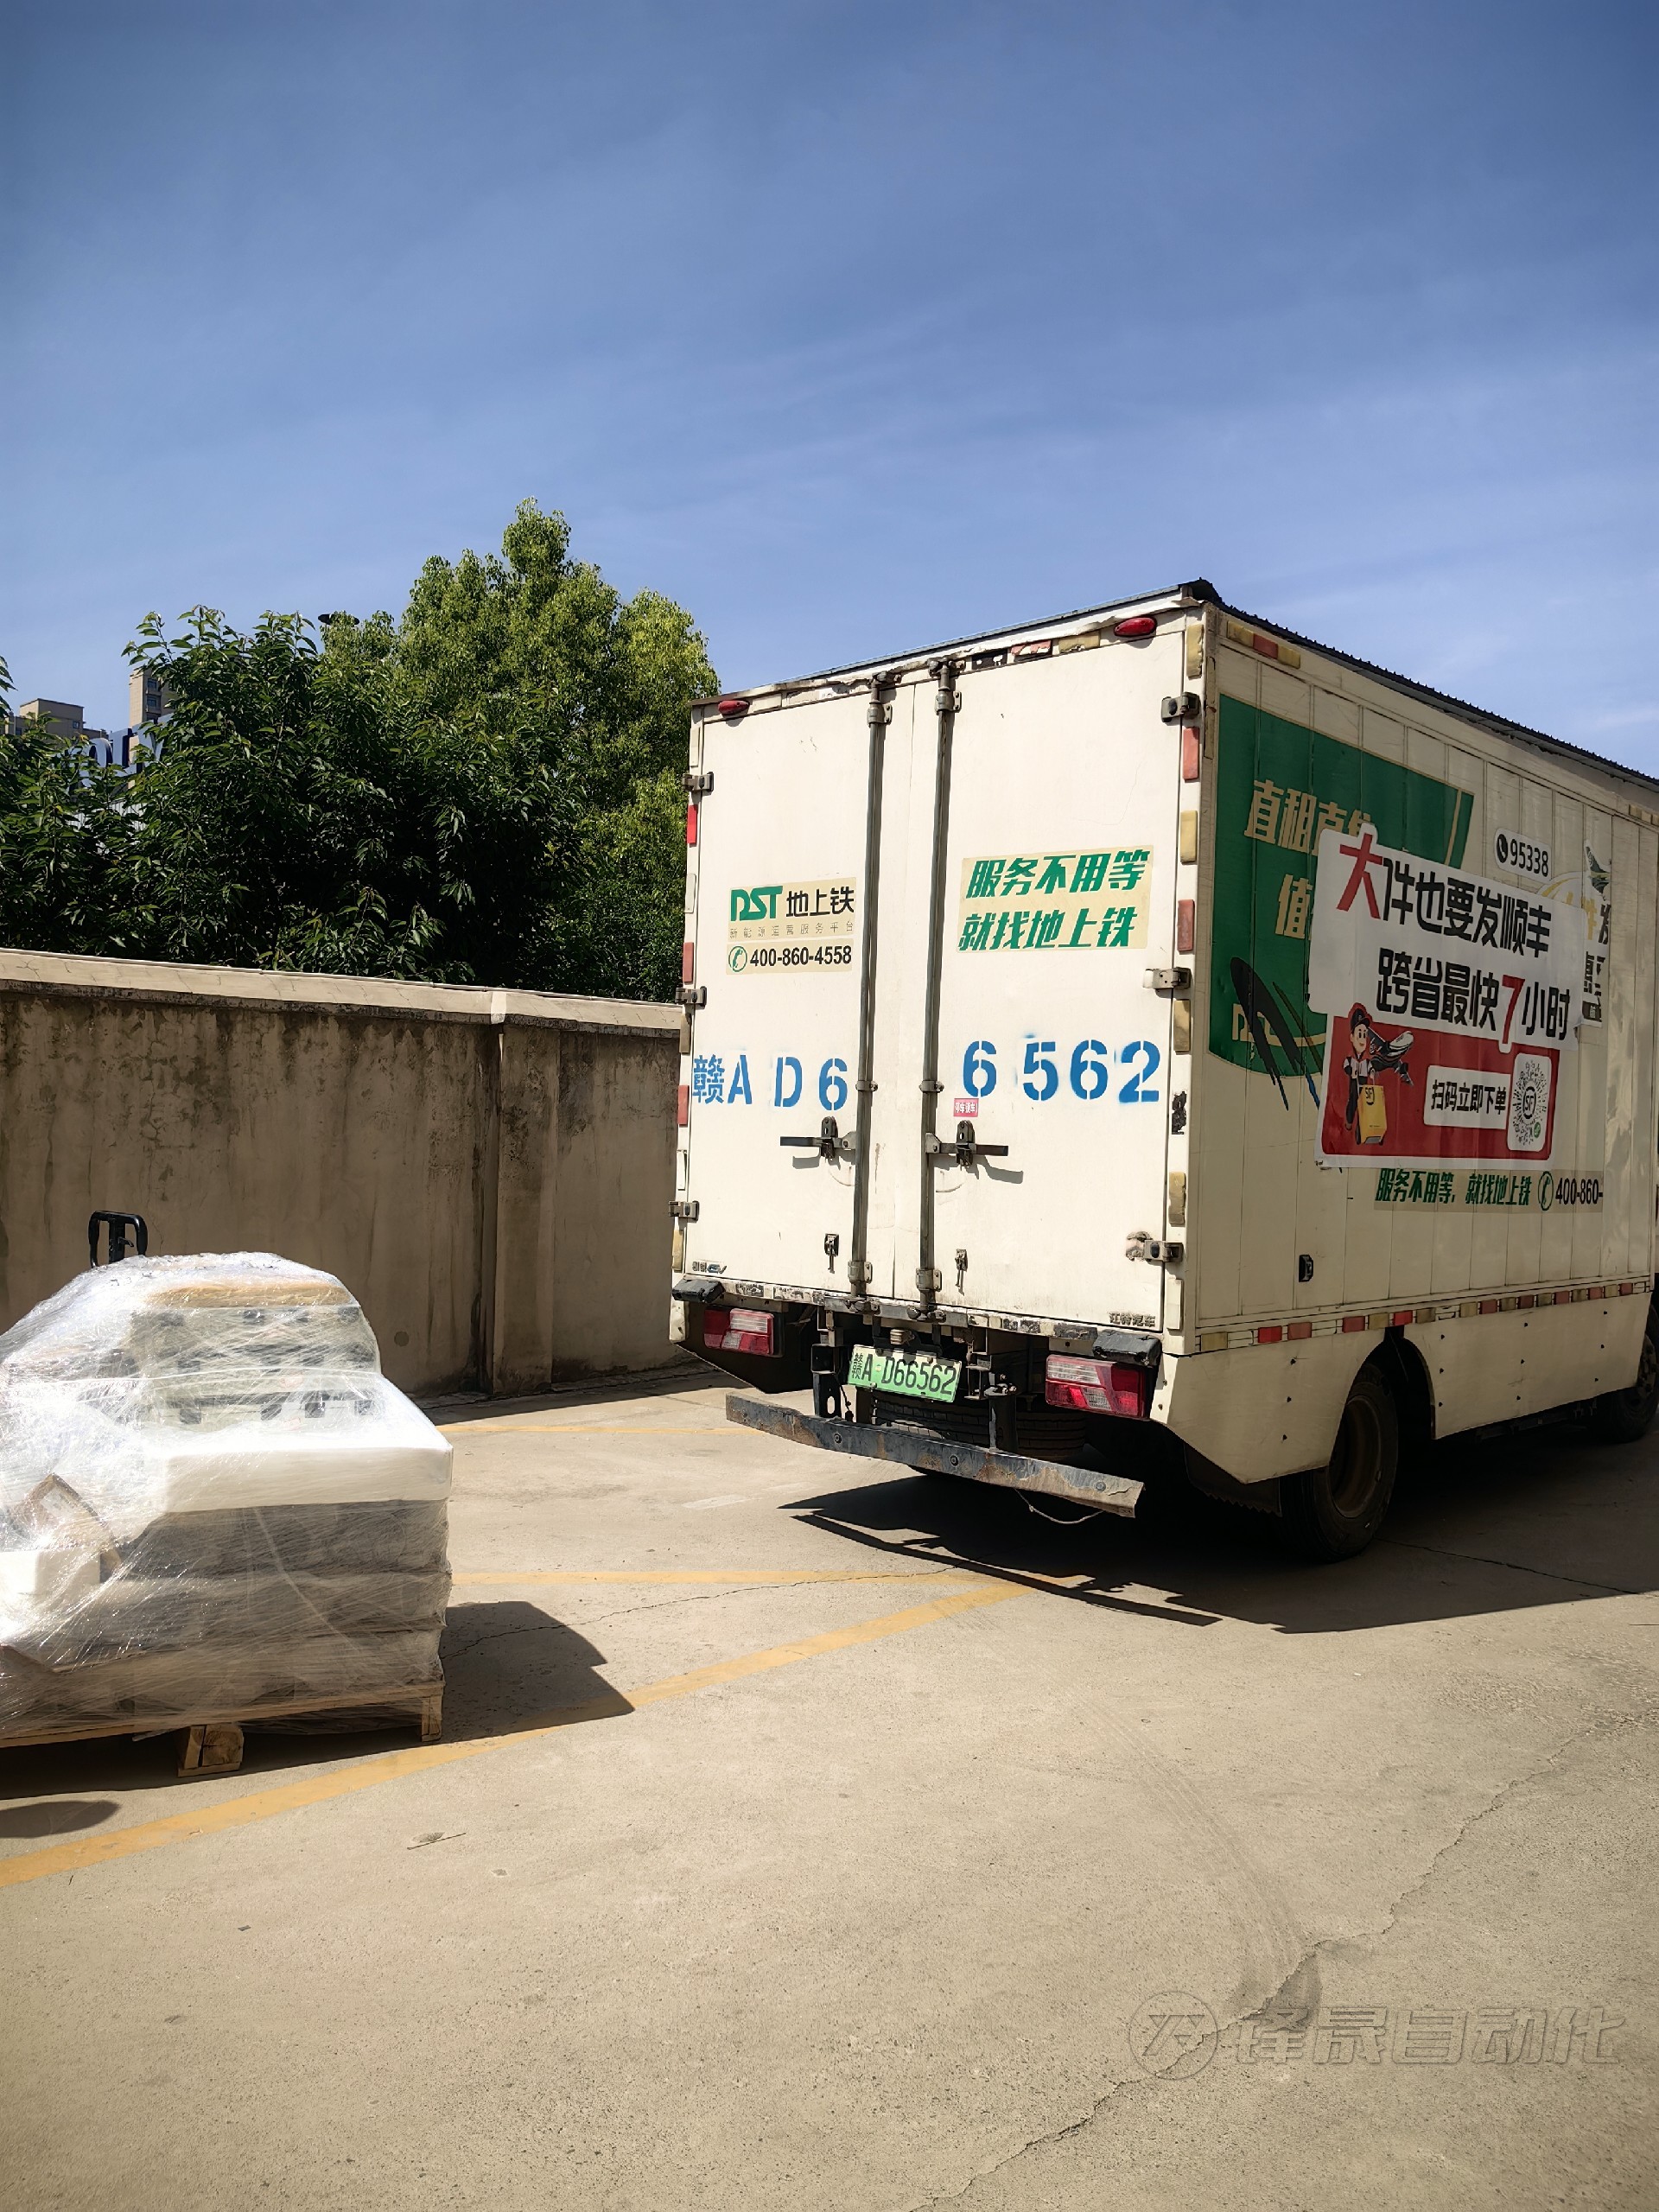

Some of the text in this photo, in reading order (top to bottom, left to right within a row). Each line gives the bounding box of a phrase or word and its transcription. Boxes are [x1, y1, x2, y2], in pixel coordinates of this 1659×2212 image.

[966, 849, 1151, 899] 服务不用等
[1510, 838, 1549, 877] 95338
[730, 886, 855, 921] DST 地上铁
[1274, 874, 1313, 940] 值
[1337, 832, 1553, 958] 大件也要发顺丰
[729, 921, 854, 938] 新能源运营服务平台
[958, 907, 1138, 950] 就找地上铁
[749, 945, 852, 967] 400-860-4558
[1376, 947, 1572, 1045] 跨省最快7小时
[1431, 1079, 1507, 1115] 扫码立即下单
